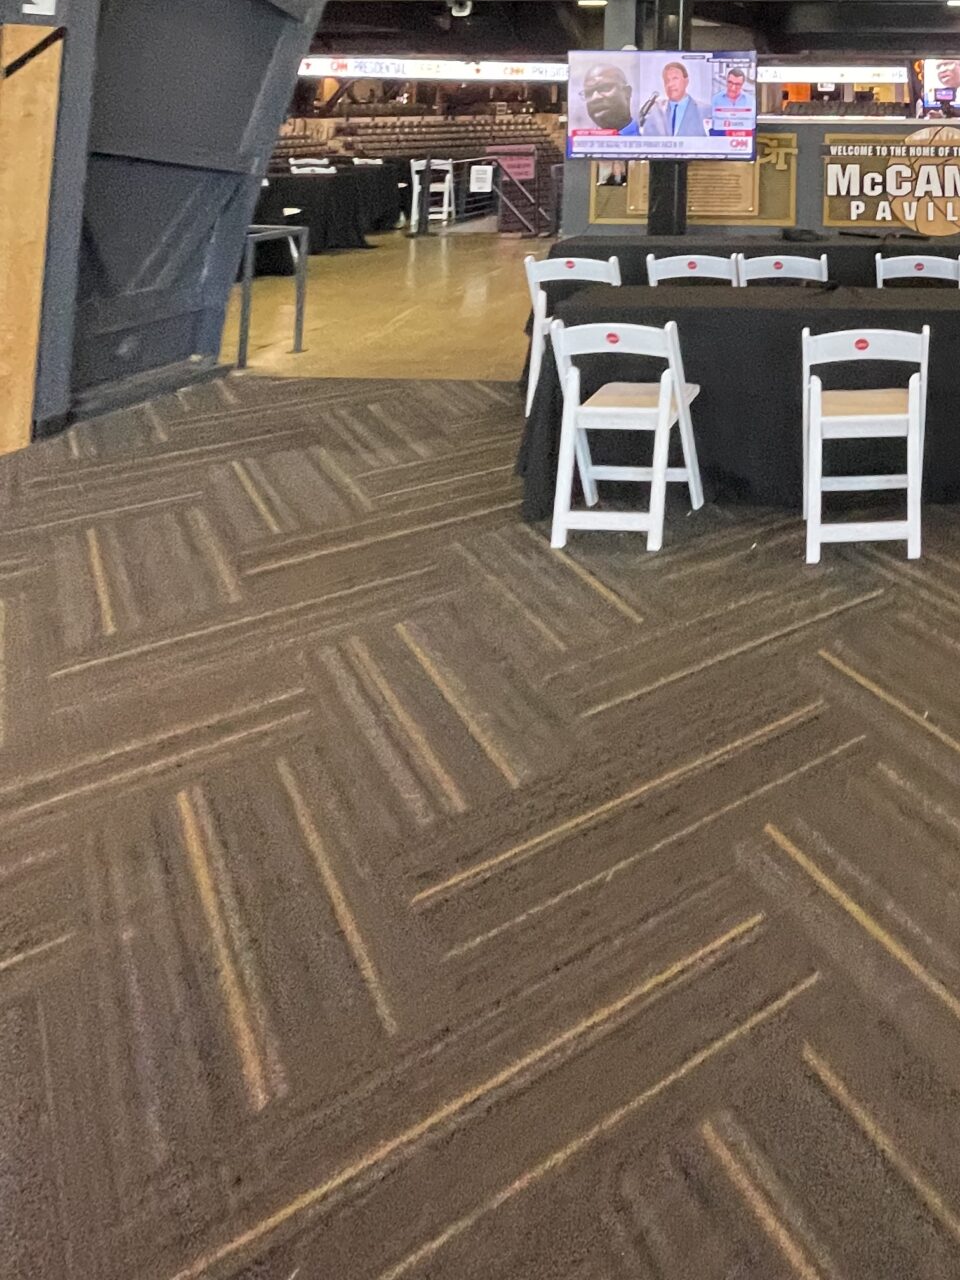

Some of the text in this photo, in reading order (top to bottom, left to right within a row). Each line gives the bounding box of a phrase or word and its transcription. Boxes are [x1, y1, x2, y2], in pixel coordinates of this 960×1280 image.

[830, 145, 873, 156] WELCOME
[876, 145, 888, 156] TO
[890, 146, 907, 157] THE
[909, 146, 935, 157] HOME
[938, 146, 950, 157] OF
